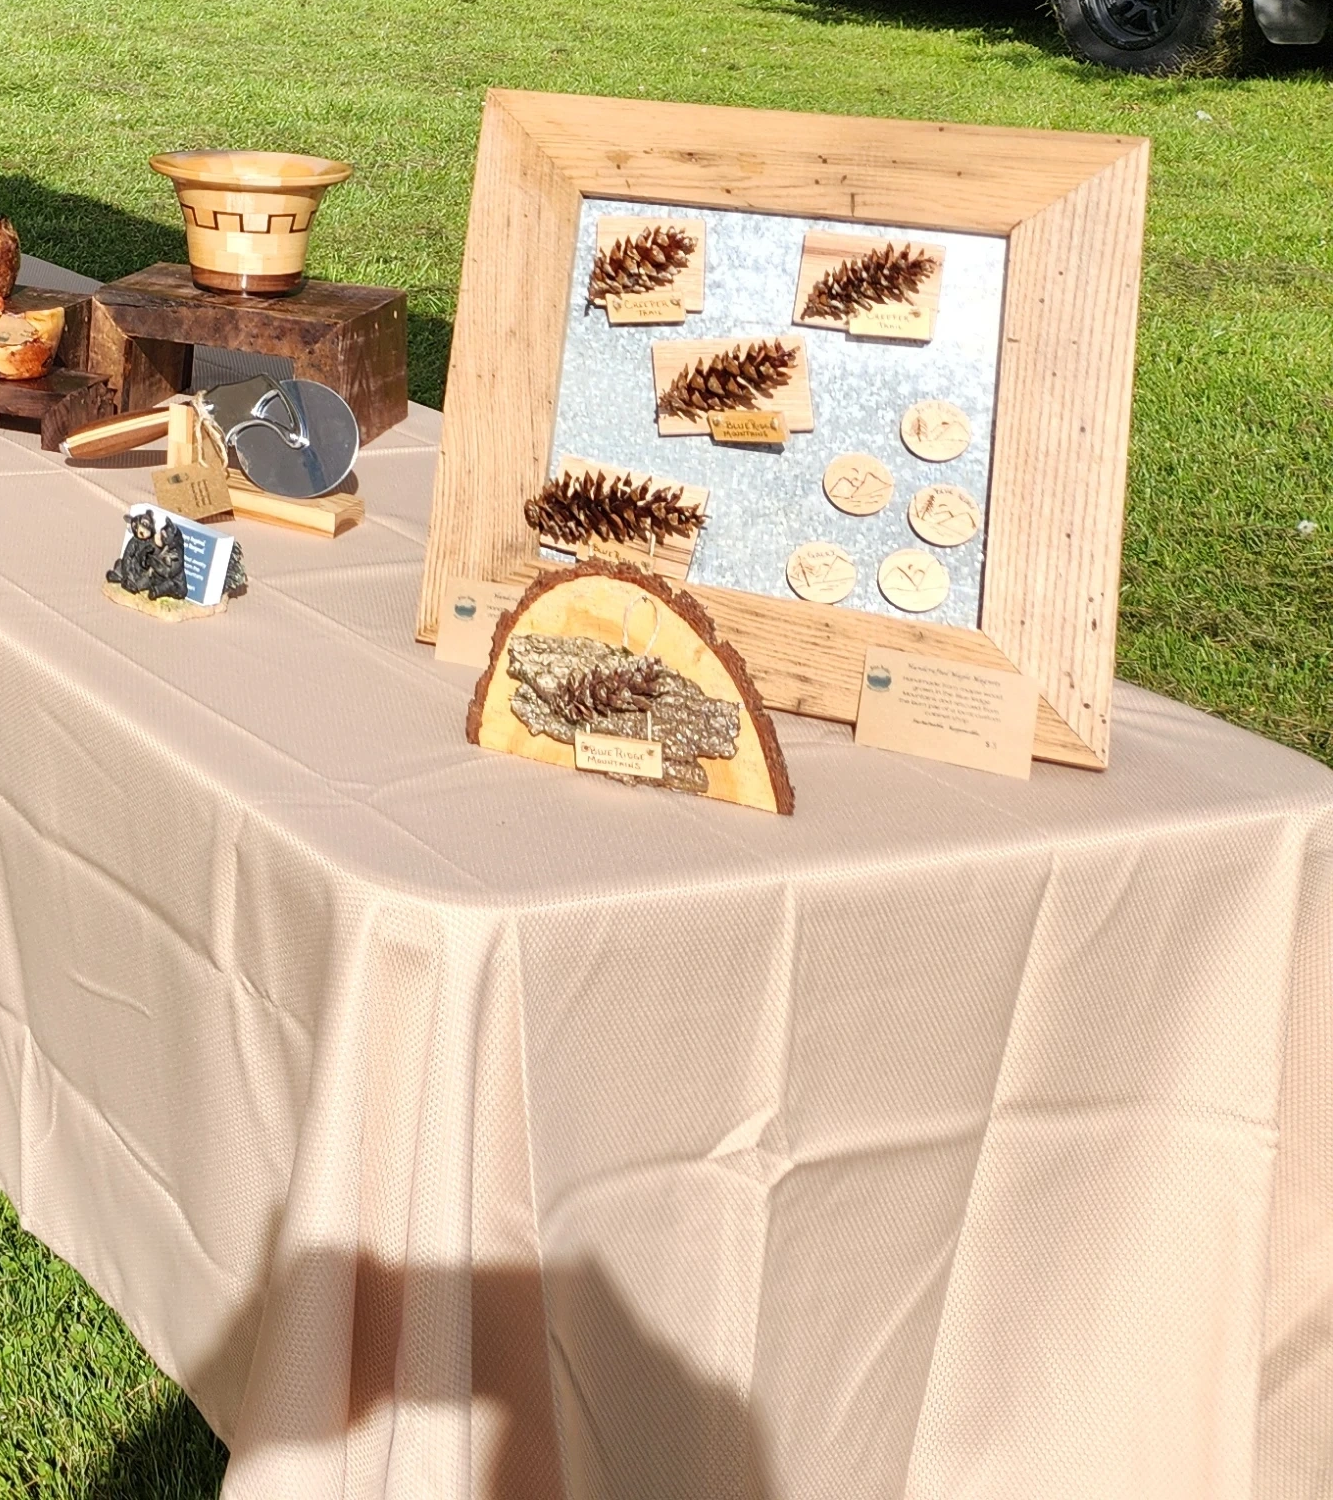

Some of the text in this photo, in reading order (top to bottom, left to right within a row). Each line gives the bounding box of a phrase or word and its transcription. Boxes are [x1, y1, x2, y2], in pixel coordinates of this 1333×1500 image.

[590, 746, 645, 761] BLUE RIDGE
[587, 755, 641, 770] MOUNTAINS
